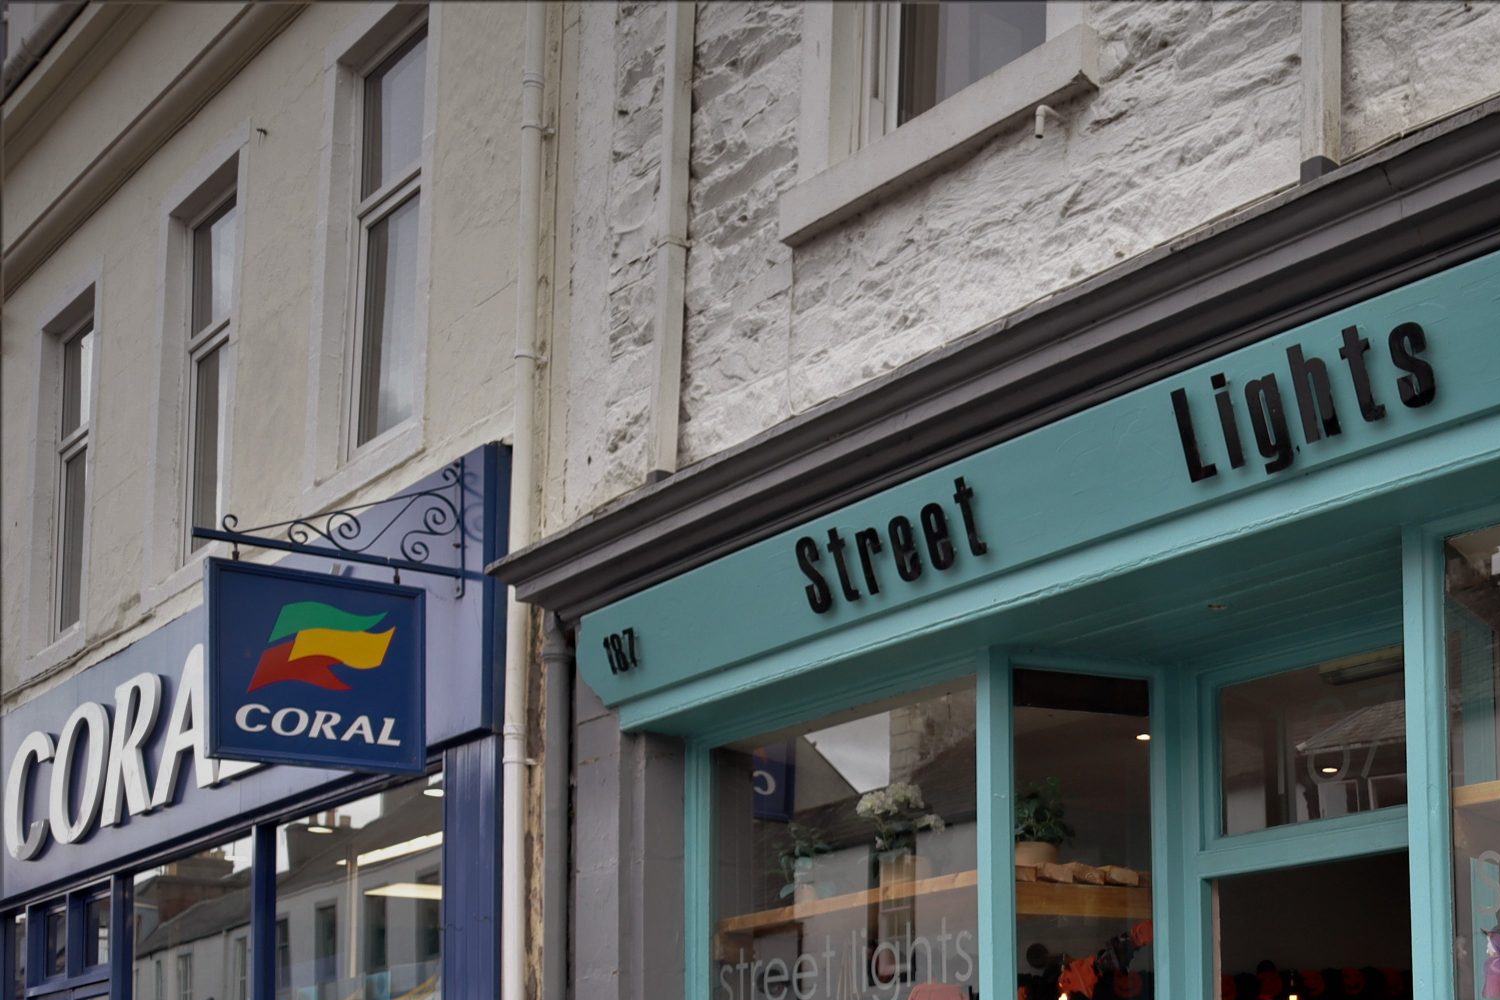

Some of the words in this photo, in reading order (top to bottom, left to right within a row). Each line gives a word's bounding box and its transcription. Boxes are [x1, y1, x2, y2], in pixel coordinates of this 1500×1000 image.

[794, 476, 988, 615] Street
[1170, 321, 1437, 482] Lights
[602, 627, 640, 675] 187
[5, 640, 268, 862] CORA
[235, 704, 401, 747] CORAL
